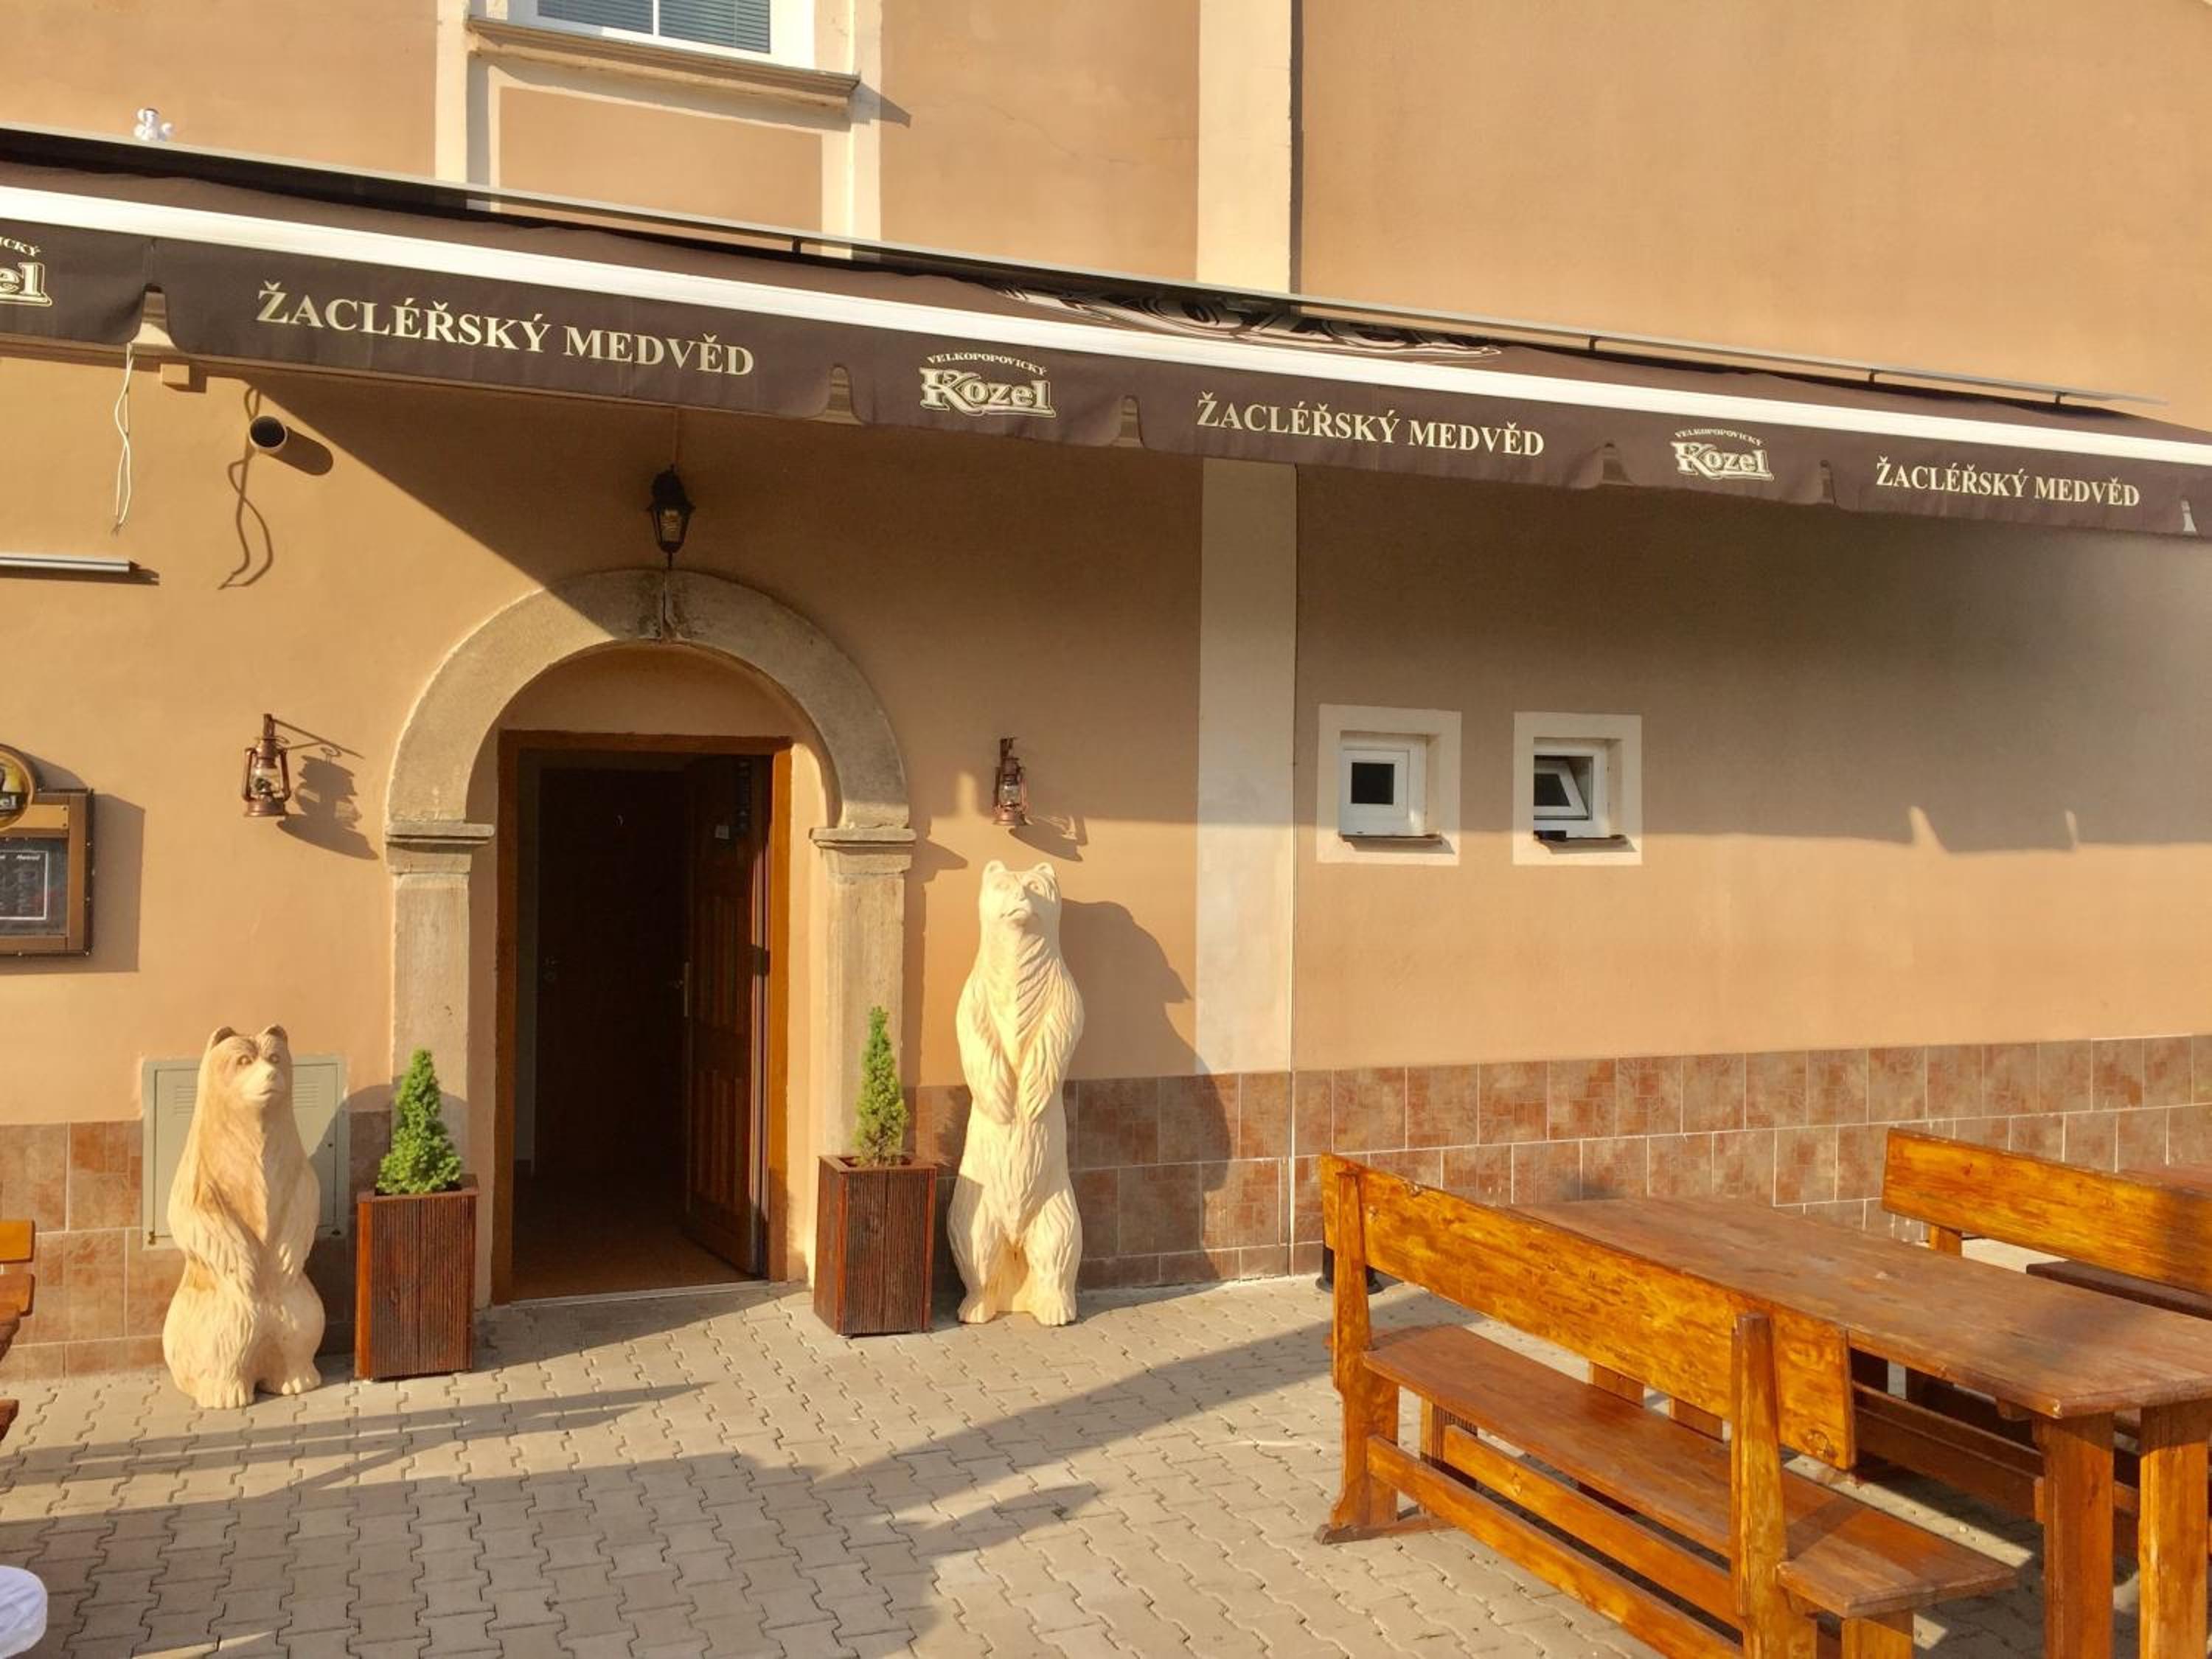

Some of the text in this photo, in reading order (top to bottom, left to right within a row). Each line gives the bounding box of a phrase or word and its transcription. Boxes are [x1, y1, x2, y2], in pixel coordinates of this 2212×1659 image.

[257, 280, 755, 376] ŽACLÉŘSKÝ MEDVĚD
[926, 352, 1048, 377] VELKOPOPOVICKÝ
[919, 366, 1057, 418] Kozel
[1196, 391, 1545, 456] ŽACLÉŘSKÝ MEDVĚD
[1669, 440, 1775, 481] Kozel
[1875, 456, 2140, 507] ŽACLÉŘSKÝ MEDVĚD
